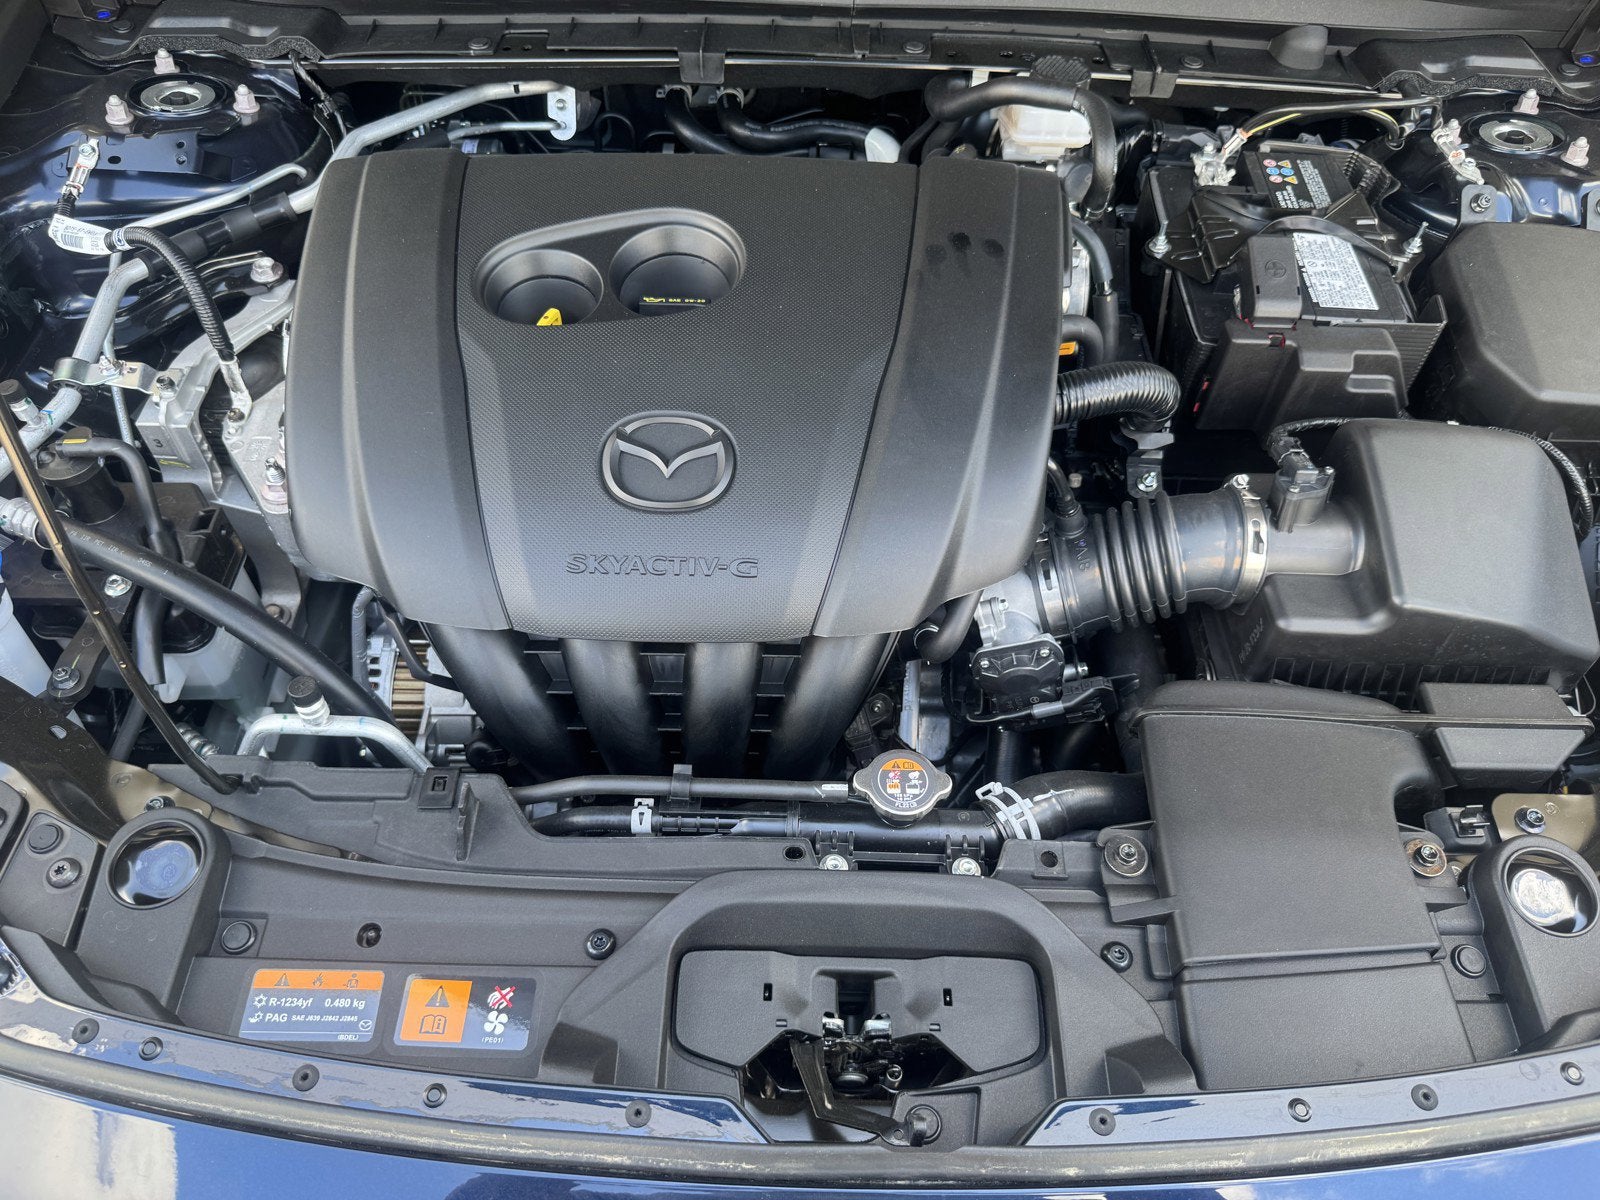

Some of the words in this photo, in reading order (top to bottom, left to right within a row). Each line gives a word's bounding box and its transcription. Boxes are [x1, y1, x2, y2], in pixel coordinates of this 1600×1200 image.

[565, 553, 759, 579] SKYACTIV-G
[268, 997, 314, 1009] R-1234yf
[324, 998, 350, 1008] 0.480
[352, 998, 366, 1010] kg
[264, 1013, 288, 1023] PAG
[481, 1036, 504, 1044] (PE01)
